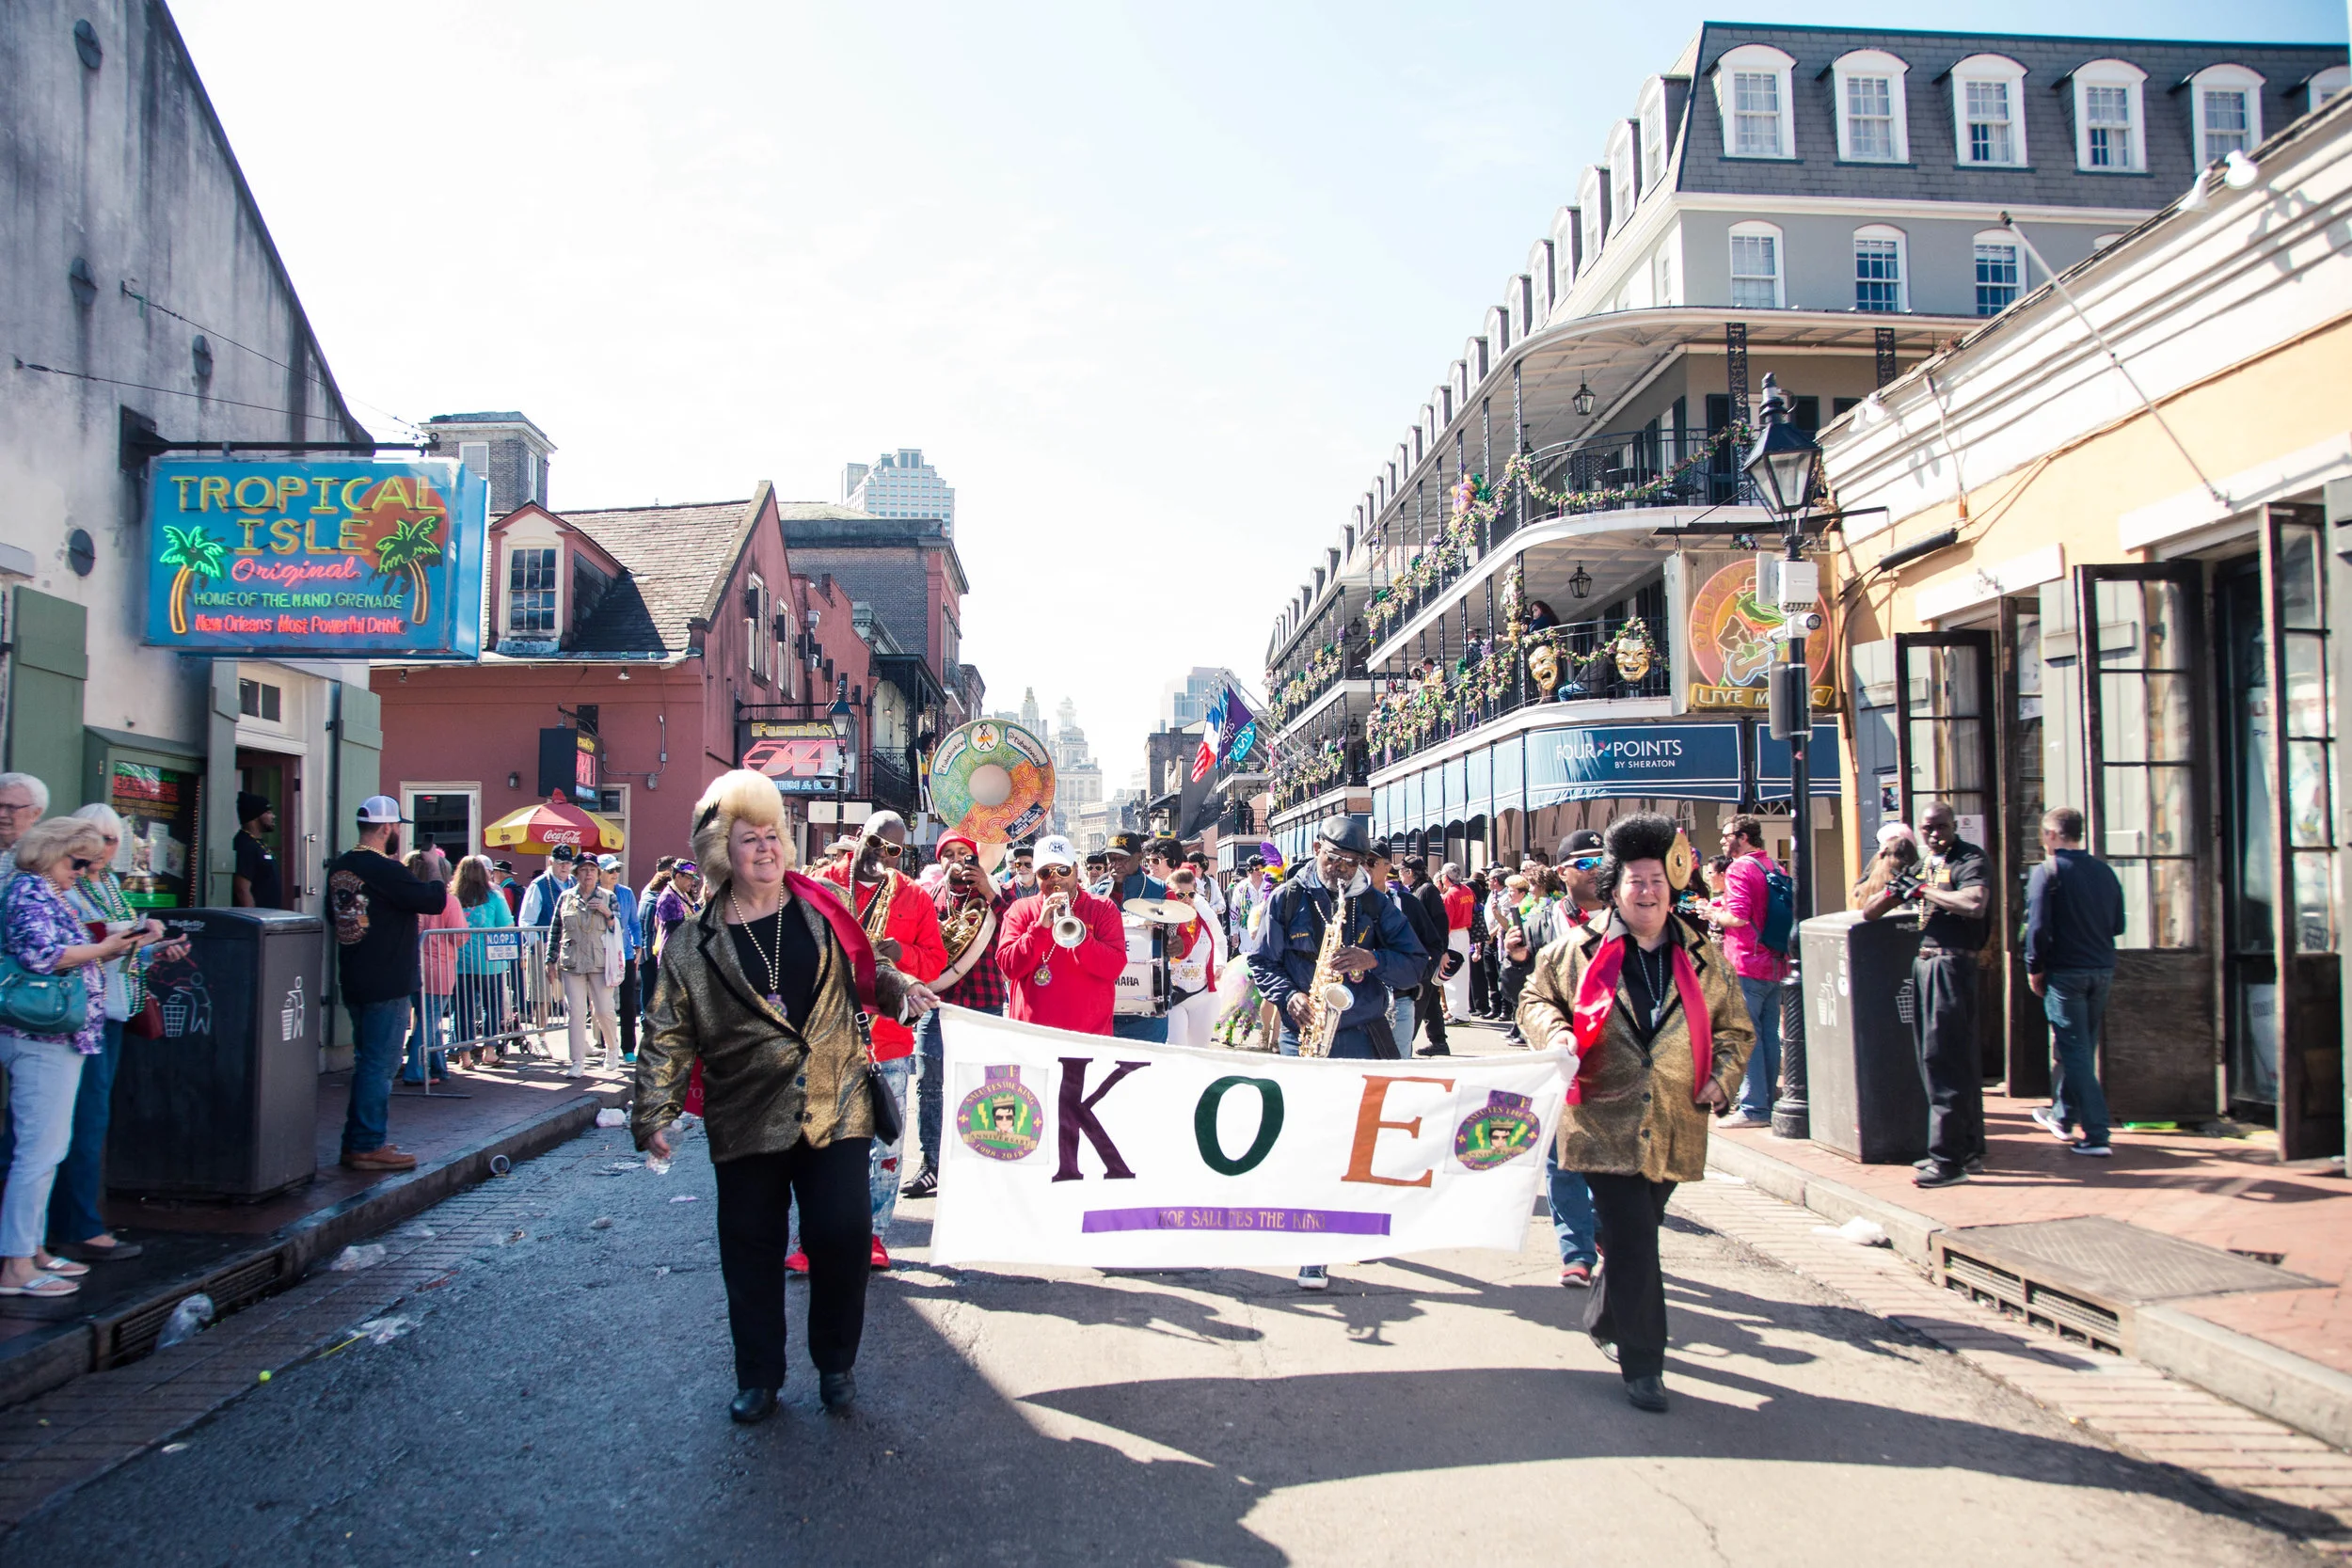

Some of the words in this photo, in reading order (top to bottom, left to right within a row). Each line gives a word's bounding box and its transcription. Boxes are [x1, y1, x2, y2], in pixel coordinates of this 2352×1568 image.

[170, 475, 446, 515] TROPICAL
[234, 518, 373, 555] ISLE
[231, 556, 360, 588] Original
[194, 592, 235, 607] HOME
[237, 592, 258, 607] OF
[261, 593, 291, 608] THE
[292, 593, 331, 608] HAND
[335, 592, 404, 609] GRENADE
[195, 613, 223, 631] New
[224, 614, 274, 632] Orleans
[278, 613, 309, 634] Most
[310, 615, 366, 634] Powerful
[367, 616, 404, 634] Drink
[1698, 689, 1743, 705] LIVE
[752, 722, 836, 738] Funky
[742, 739, 847, 776] 544
[1556, 743, 1596, 760] FOUR
[1613, 739, 1683, 757] POINTS
[1614, 760, 1625, 768] BY
[1628, 759, 1676, 768] SHERATON
[543, 829, 581, 845] Coca-Cola
[985, 1064, 1019, 1080] KOE
[965, 1082, 1002, 1103] SALUTES
[1002, 1081, 1016, 1091] THE
[1017, 1085, 1037, 1105] KING
[970, 1132, 1030, 1147] ANNIVERSARY
[1158, 1210, 1185, 1228] KOE
[1190, 1210, 1253, 1227] SALUTES
[1257, 1211, 1285, 1228] THE
[1293, 1212, 1327, 1230] KING
